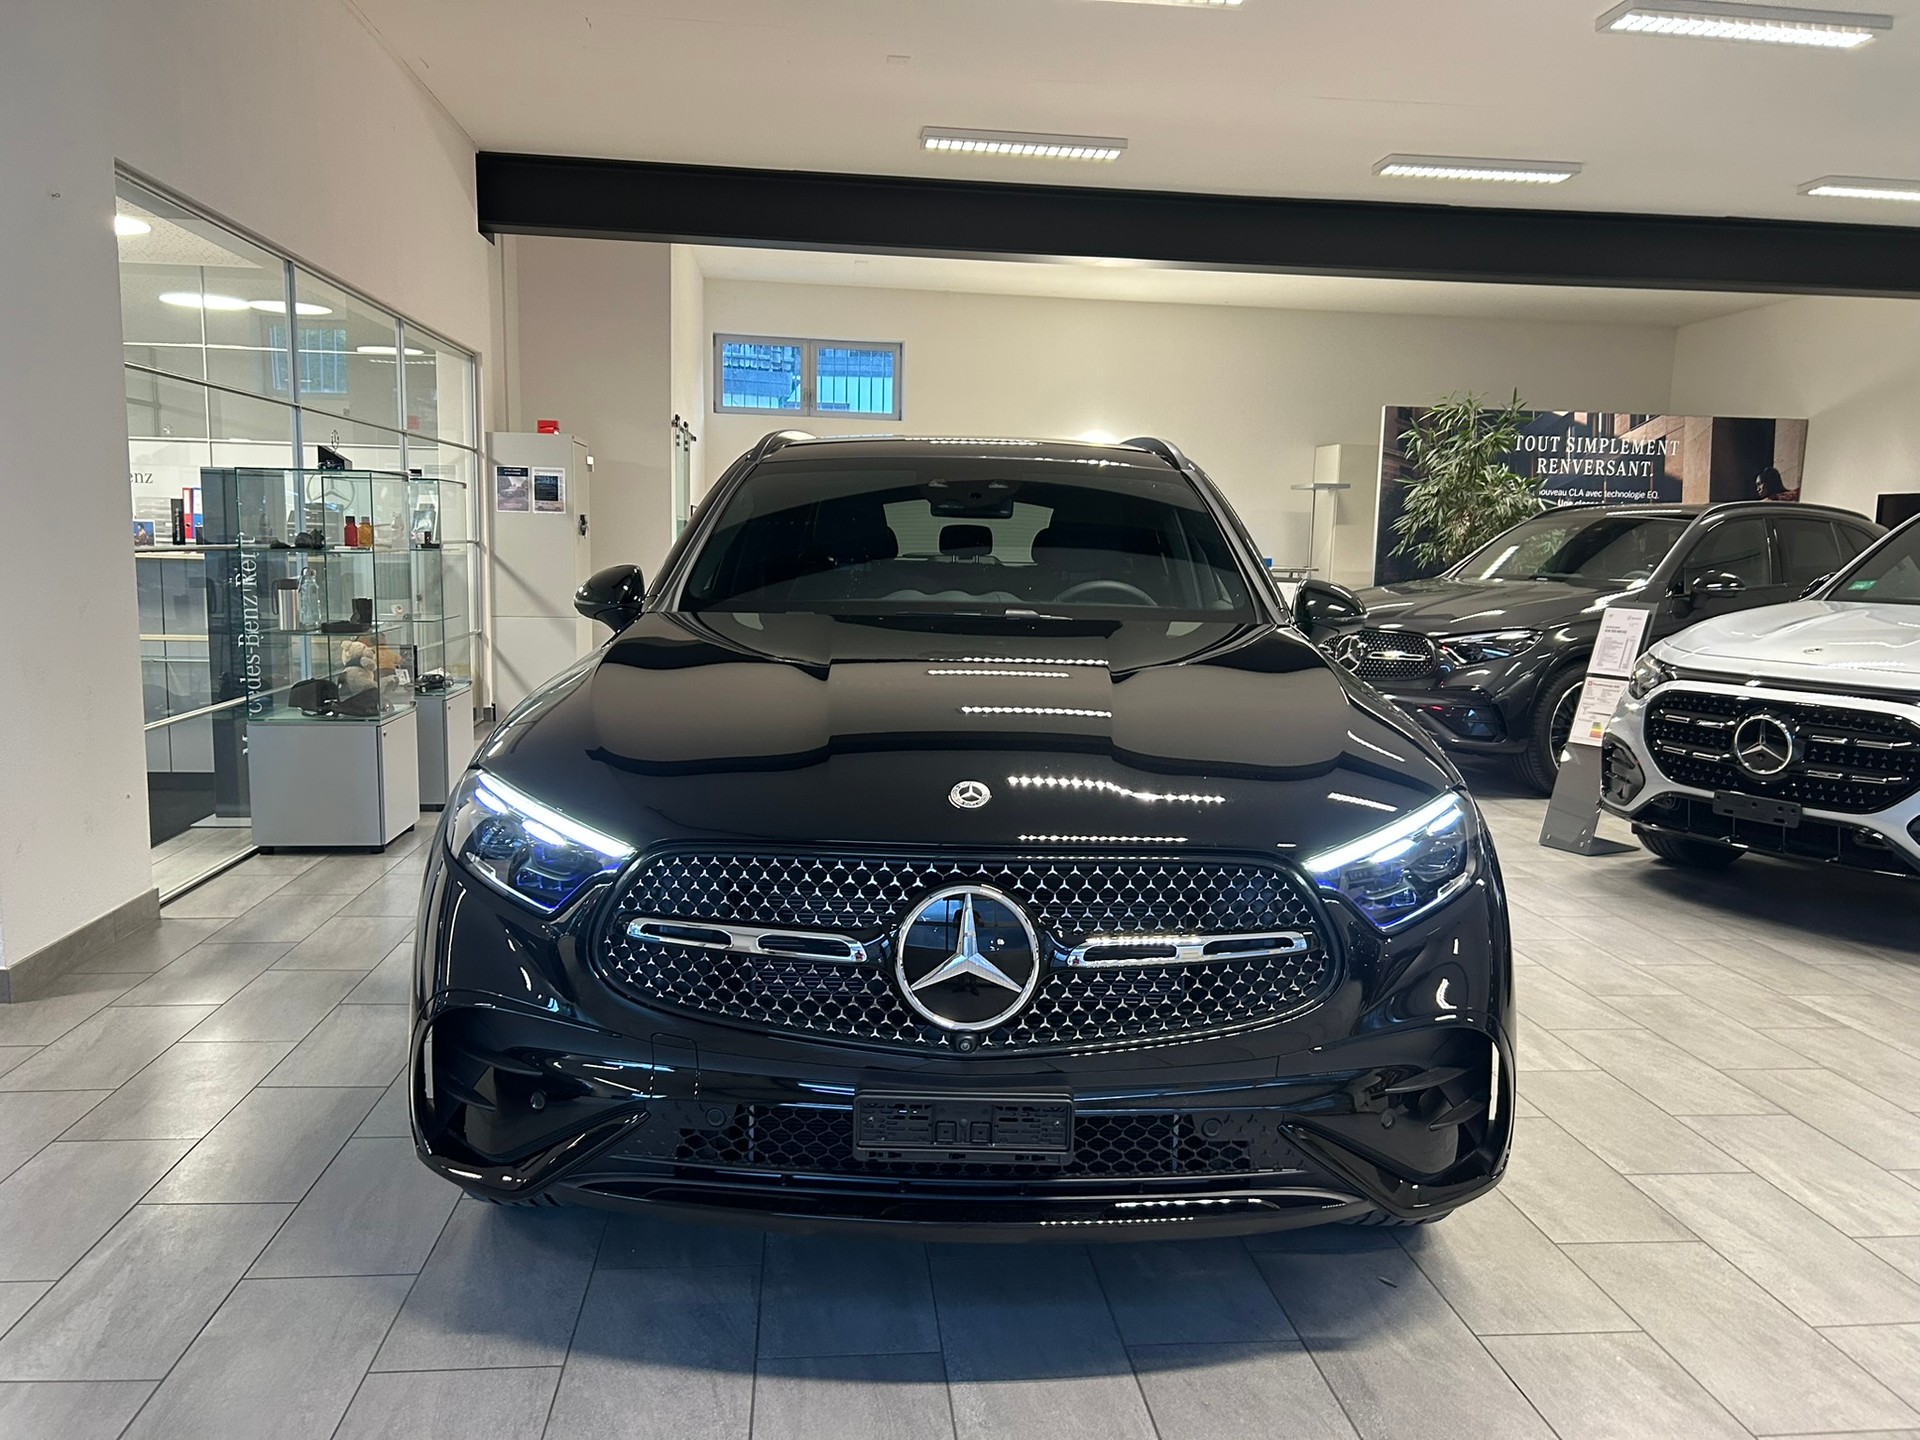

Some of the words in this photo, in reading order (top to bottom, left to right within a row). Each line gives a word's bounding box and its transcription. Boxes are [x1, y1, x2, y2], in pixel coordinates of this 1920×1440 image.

[1512, 434, 1561, 453] TOUT
[1566, 436, 1680, 456] SIMPLEMENT
[1536, 457, 1654, 477] RENVERSANT.
[1568, 488, 1584, 497] CLA
[1585, 490, 1602, 498] avec
[1604, 489, 1645, 500] technologie
